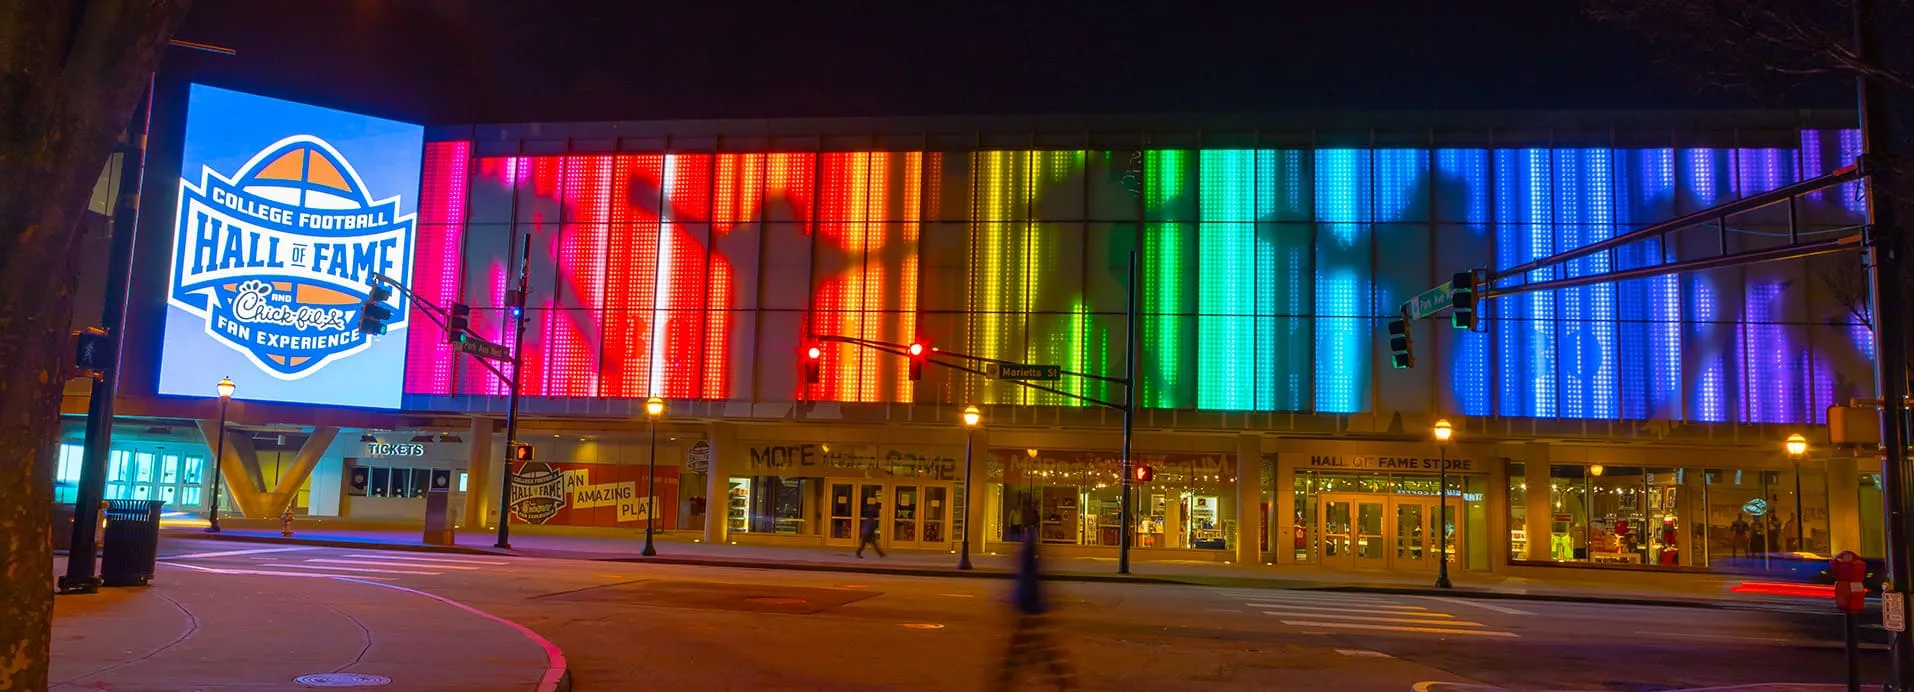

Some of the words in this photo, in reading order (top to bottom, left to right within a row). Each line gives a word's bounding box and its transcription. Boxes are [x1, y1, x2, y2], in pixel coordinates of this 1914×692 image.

[212, 187, 294, 226] COLLEGE
[299, 212, 388, 230] FOOTBALL
[191, 210, 284, 276] HALL
[291, 246, 307, 264] OF
[312, 237, 397, 293] FAME
[271, 293, 292, 303] AND
[217, 315, 250, 341] FAN
[256, 327, 360, 350] EXPERIENCE
[1002, 367, 1042, 377] Marietta
[1047, 368, 1057, 377] St
[368, 442, 424, 456] TICKETS
[1311, 455, 1348, 467] HALL
[1378, 457, 1419, 469] FAME
[1423, 458, 1472, 470] STORE
[567, 474, 585, 487] AN
[511, 482, 531, 504] HALL
[539, 480, 561, 498] FAME
[577, 486, 631, 503] AMAZING
